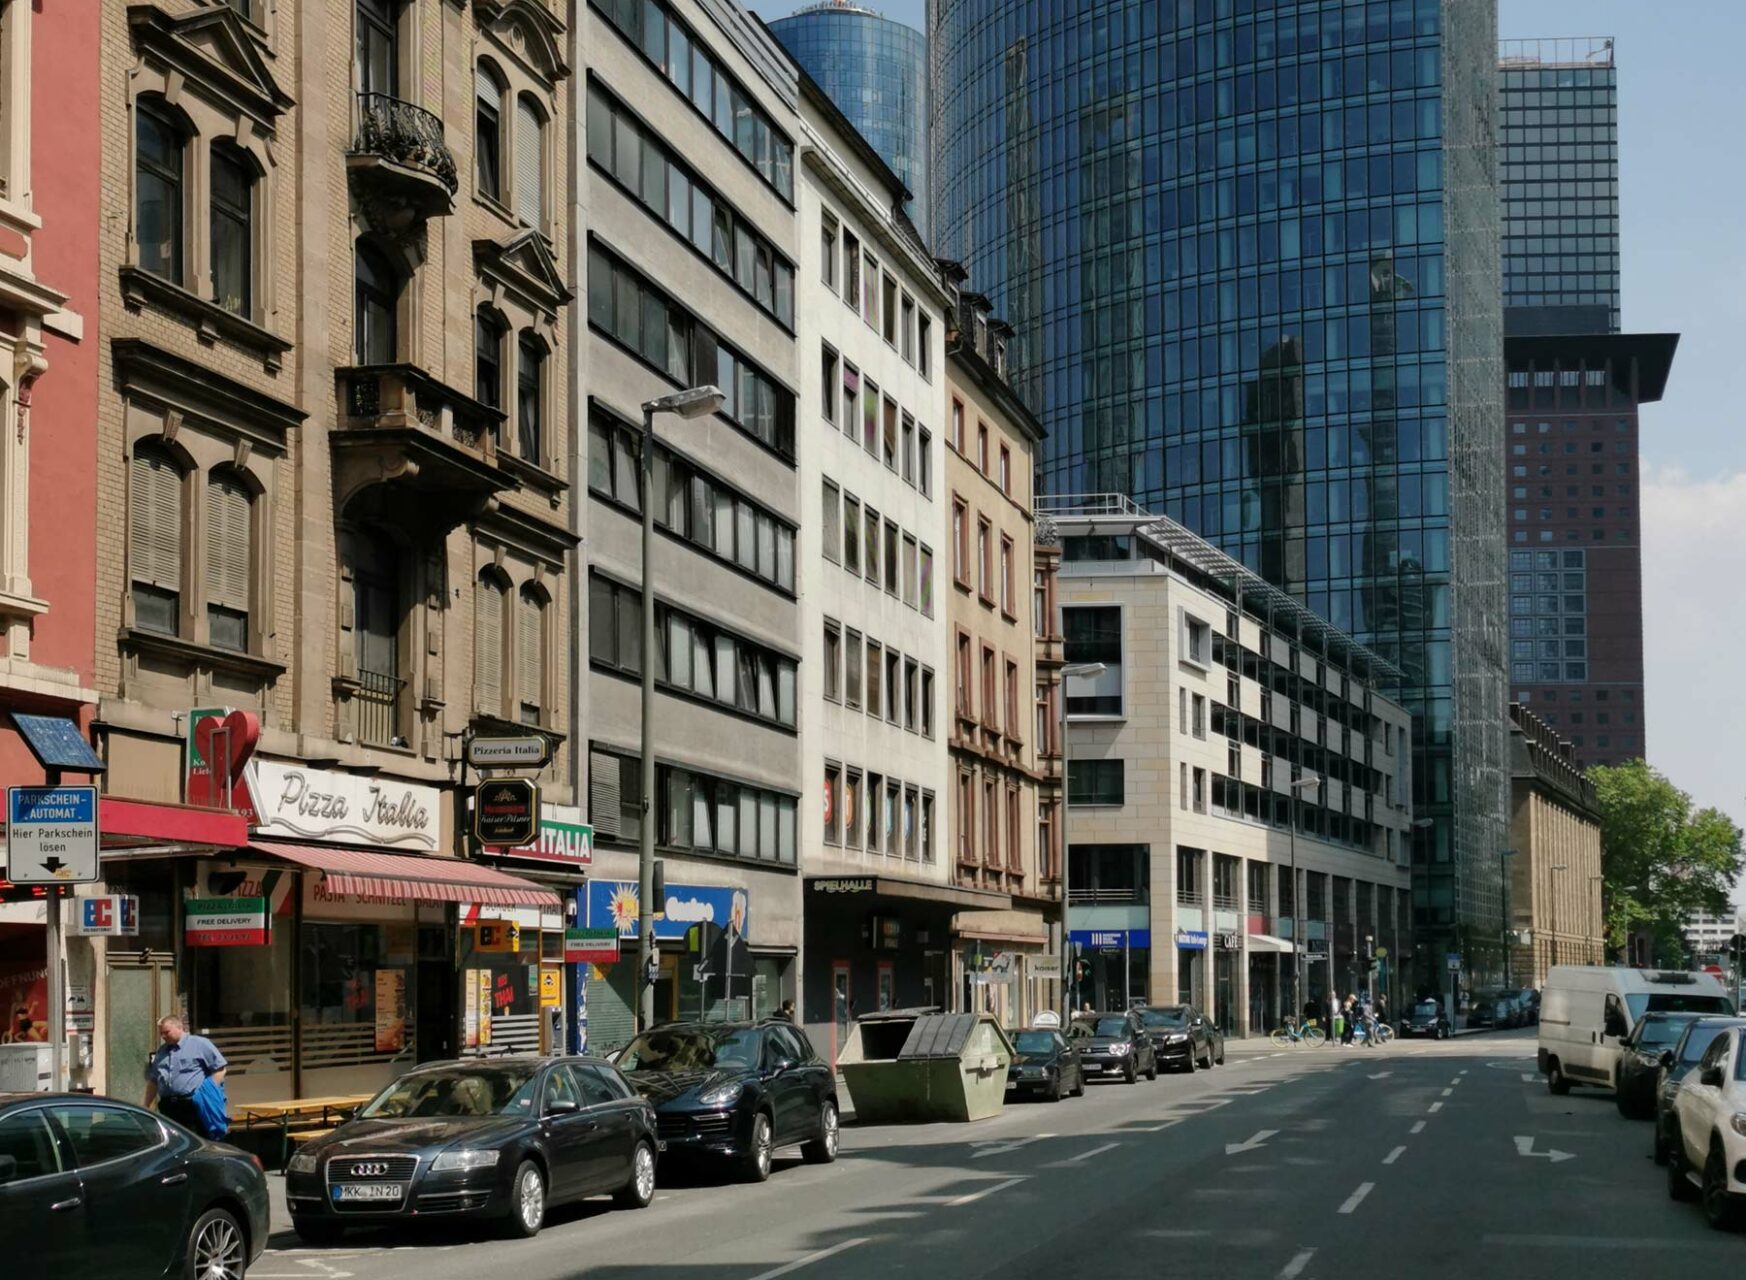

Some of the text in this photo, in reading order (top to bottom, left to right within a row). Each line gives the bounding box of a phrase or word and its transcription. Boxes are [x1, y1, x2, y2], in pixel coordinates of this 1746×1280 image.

[473, 745, 541, 755] Pizzeria Italia
[18, 793, 88, 806] PARKSCHEIN-
[277, 770, 430, 829] Pizza Italia
[29, 807, 77, 820] AUTOMAT
[12, 828, 94, 839] Hier Parkschein
[39, 841, 67, 852] lösen
[540, 826, 592, 859] ITALIA
[230, 880, 262, 897] IZZA
[814, 879, 873, 893] SPIELHALLE
[196, 917, 252, 926] FREE DELIVERY
